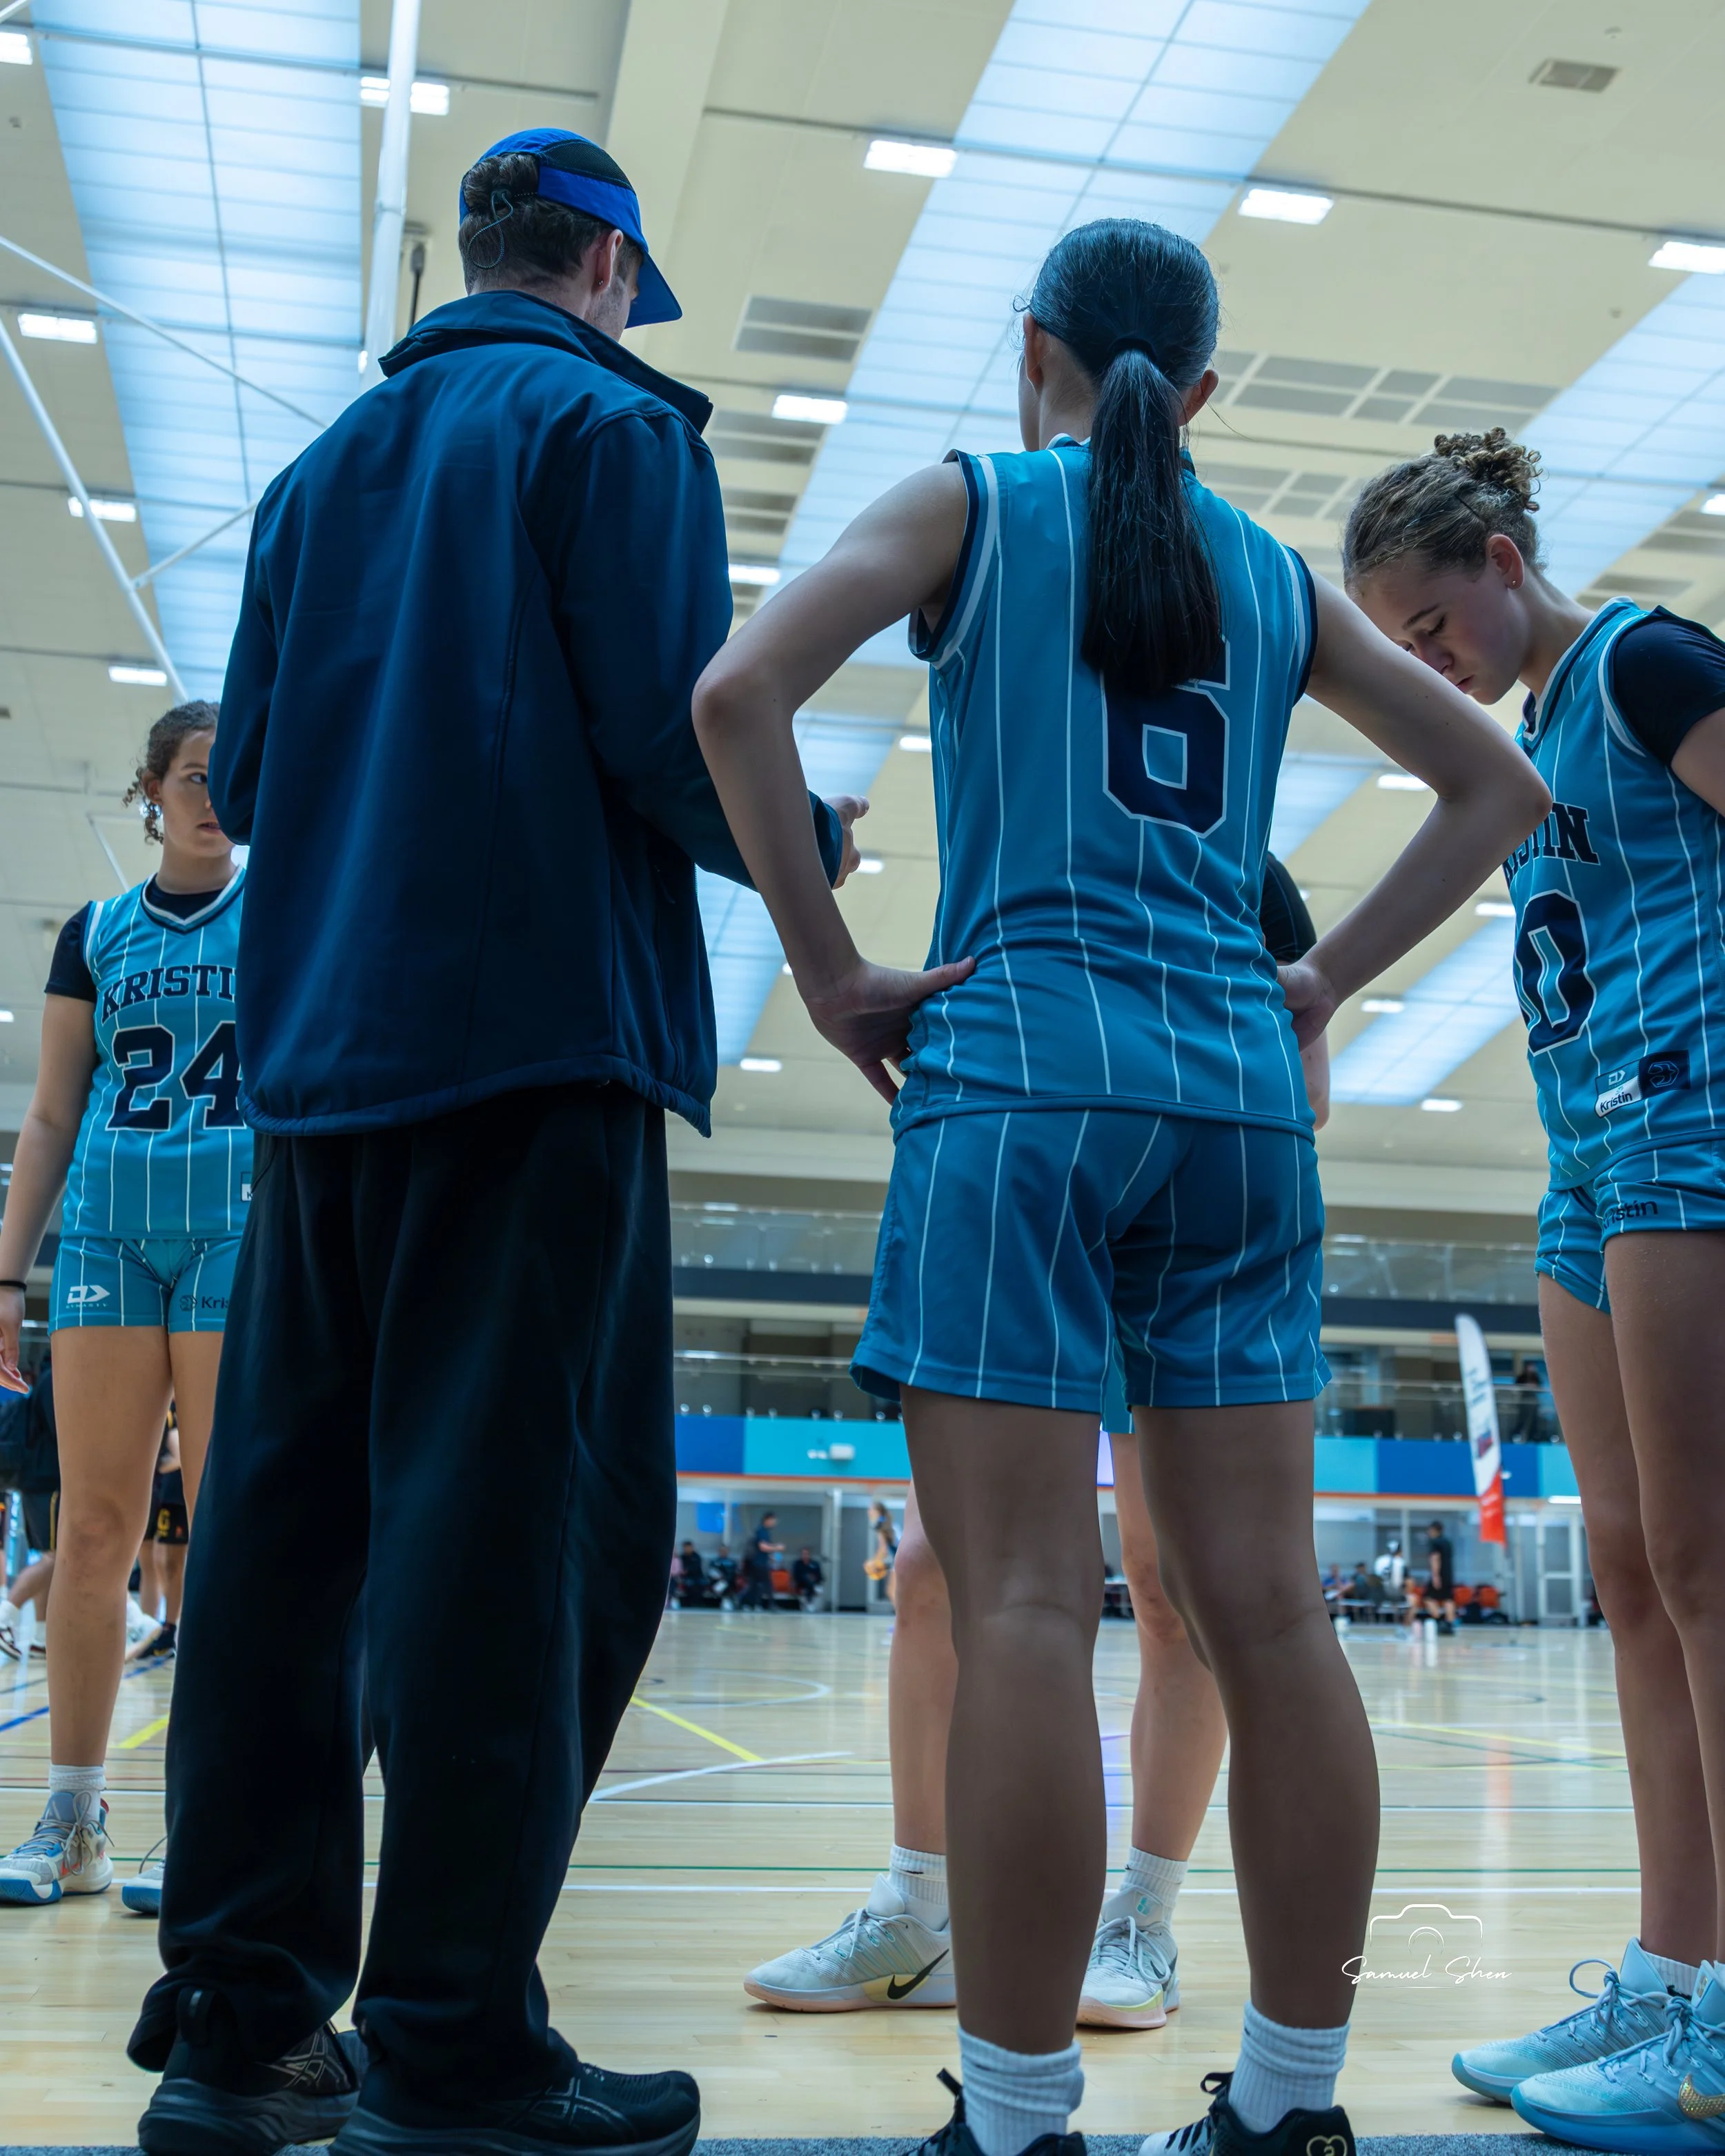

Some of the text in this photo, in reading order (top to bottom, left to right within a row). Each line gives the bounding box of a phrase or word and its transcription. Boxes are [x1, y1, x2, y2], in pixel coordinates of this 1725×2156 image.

[101, 964, 235, 1027] KRISTI
[105, 1020, 247, 1132] 24
[1600, 1091, 1633, 1113] Kristin
